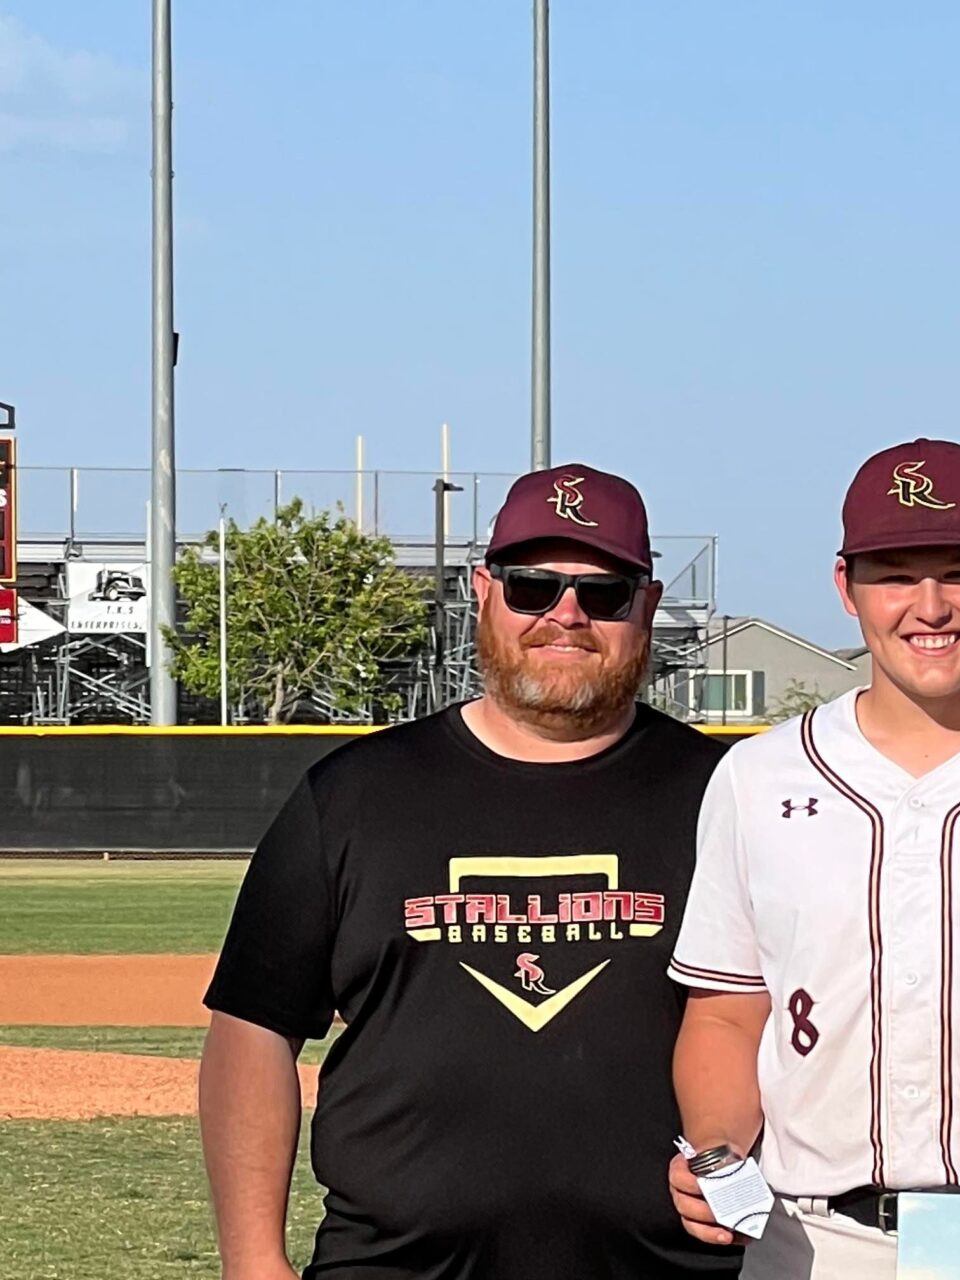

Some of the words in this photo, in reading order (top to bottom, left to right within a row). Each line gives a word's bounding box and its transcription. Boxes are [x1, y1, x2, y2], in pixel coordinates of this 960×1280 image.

[404, 891, 666, 928] STALLIONS
[448, 923, 624, 943] BASEBALL
[786, 987, 820, 1058] 8
